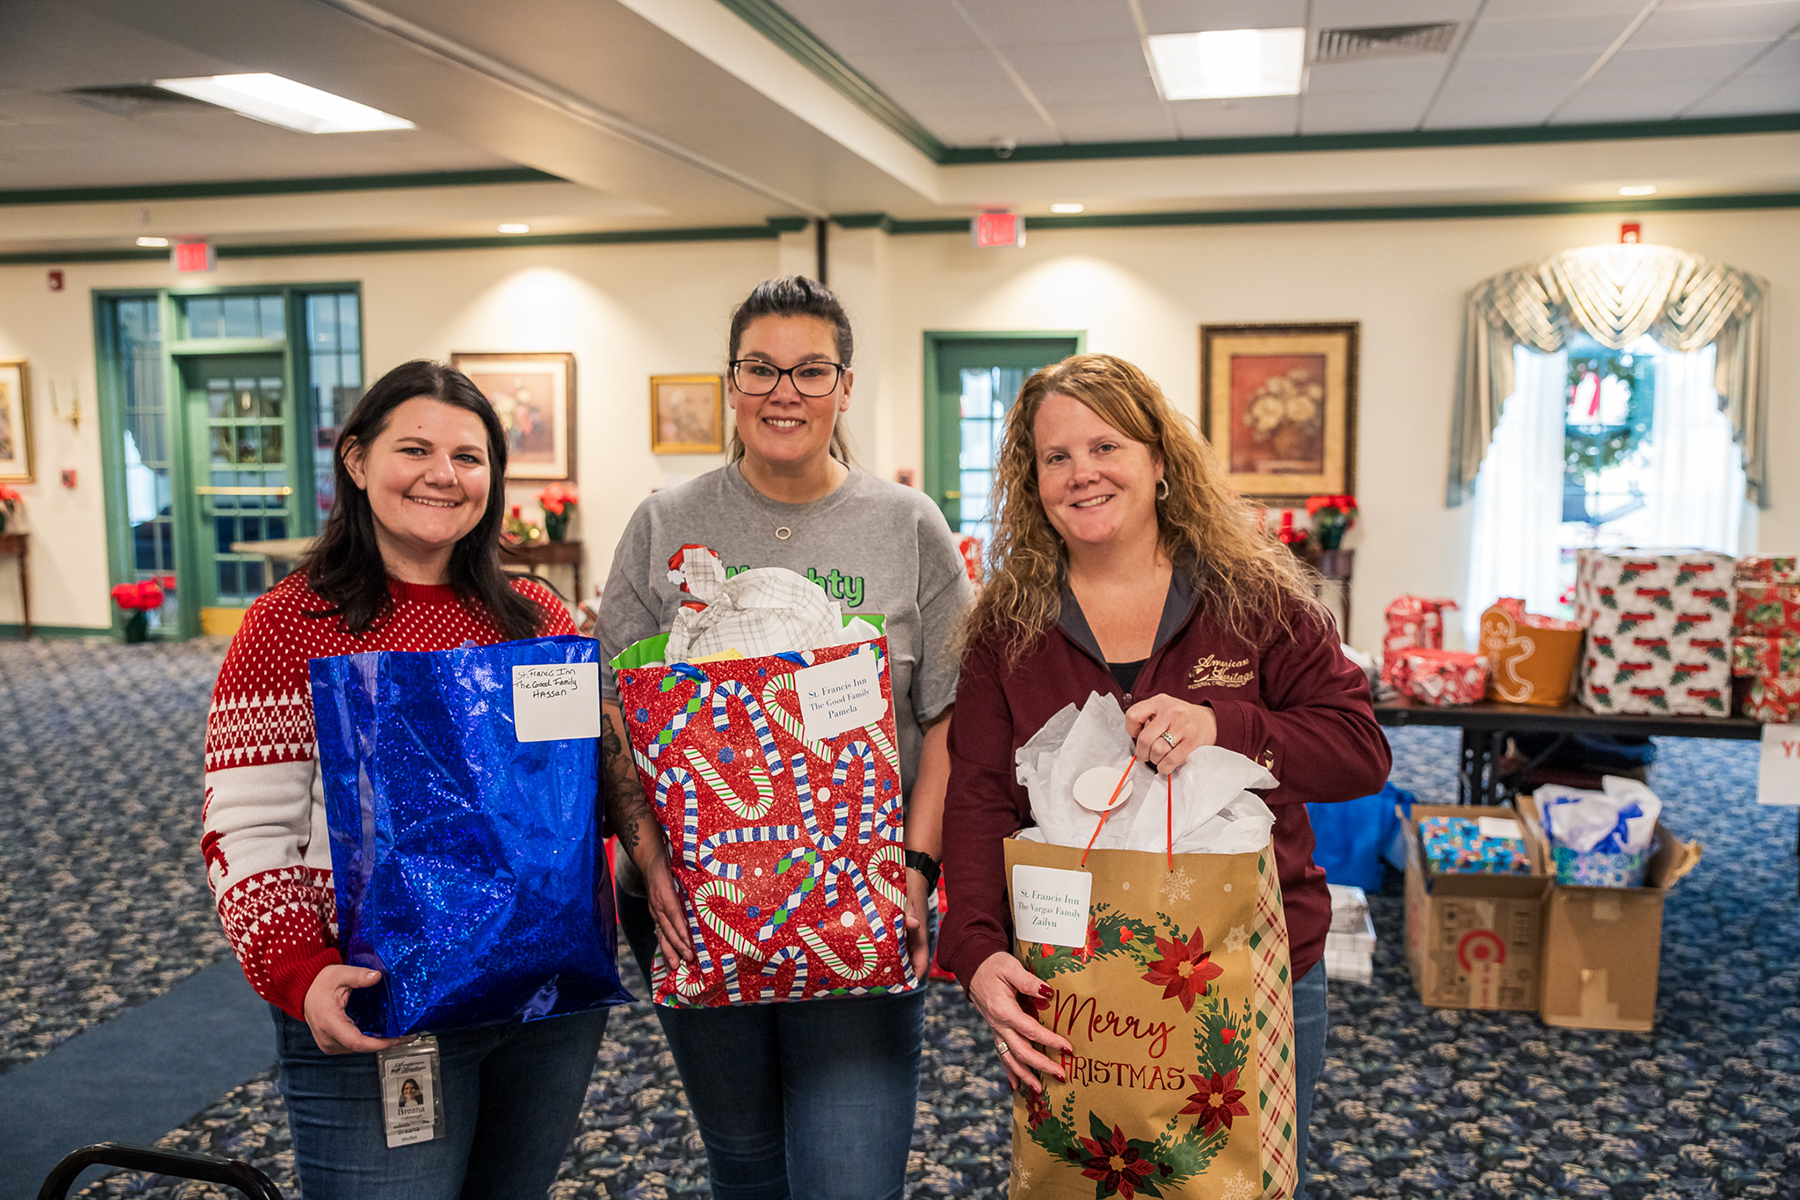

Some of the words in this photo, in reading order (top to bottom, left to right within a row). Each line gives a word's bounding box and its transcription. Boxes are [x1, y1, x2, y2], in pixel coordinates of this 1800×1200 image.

[1193, 654, 1249, 668] American
[556, 668, 576, 677] Inn
[1208, 666, 1255, 686] Heritage
[513, 680, 530, 690] The
[553, 677, 578, 690] Family
[808, 690, 820, 699] St.
[821, 681, 852, 696] Francis
[853, 677, 868, 687] Inn
[809, 702, 824, 711] The
[826, 695, 846, 707] Good
[847, 688, 870, 701] Family
[828, 705, 858, 719] Pamela
[1020, 888, 1030, 898] St.
[1031, 889, 1062, 903] Francis
[1064, 894, 1080, 906] Inn
[1018, 901, 1029, 911] The
[1030, 903, 1054, 915] Vargas
[1055, 906, 1081, 920] Family
[1032, 916, 1058, 929] Zailyn
[1053, 989, 1176, 1059] Merry
[1043, 1046, 1185, 1091] HRISTMAS
